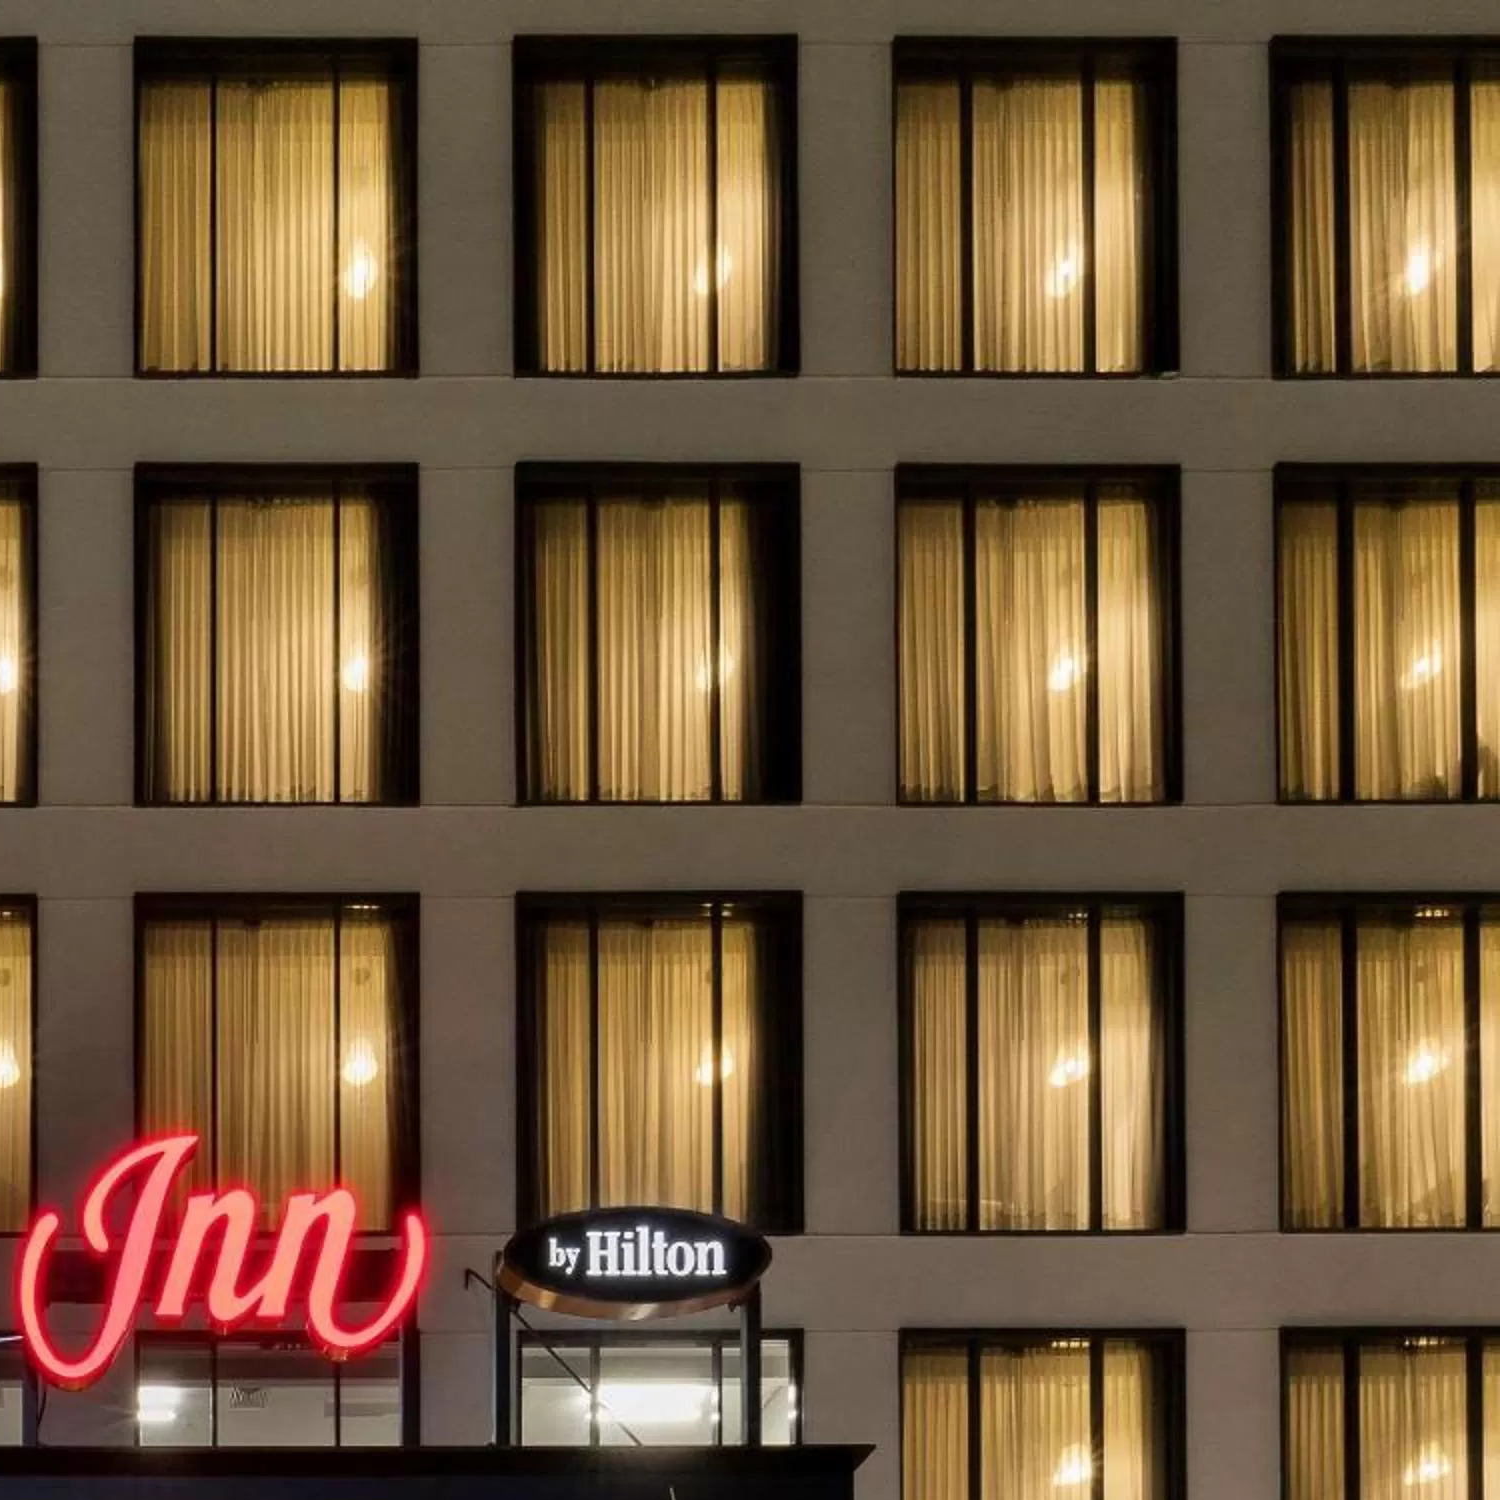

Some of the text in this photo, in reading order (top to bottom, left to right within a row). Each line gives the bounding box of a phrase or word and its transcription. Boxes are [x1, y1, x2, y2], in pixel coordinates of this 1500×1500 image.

[20, 1134, 426, 1380] Inn
[548, 1224, 728, 1277] by Hilton
